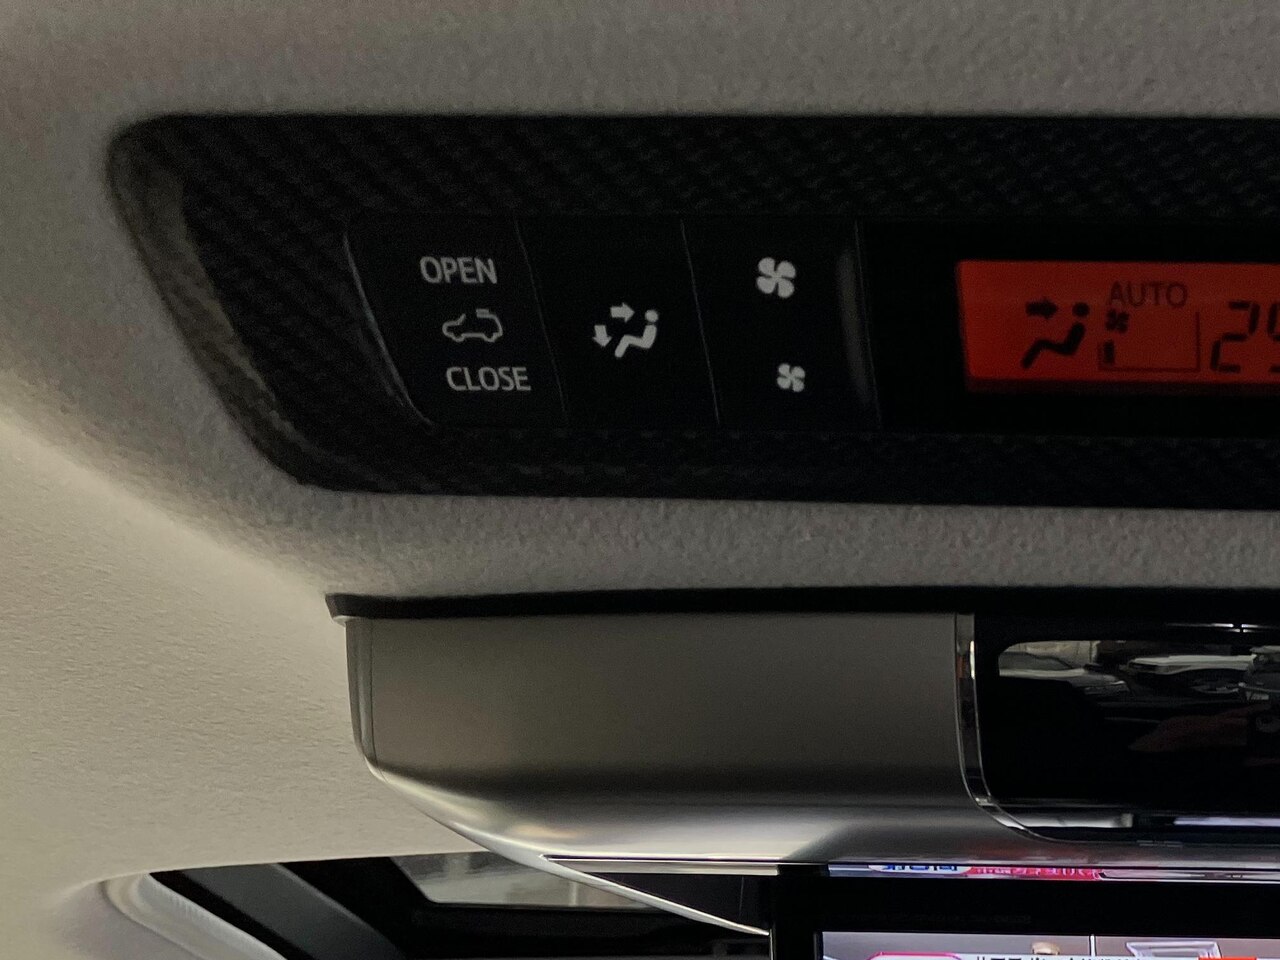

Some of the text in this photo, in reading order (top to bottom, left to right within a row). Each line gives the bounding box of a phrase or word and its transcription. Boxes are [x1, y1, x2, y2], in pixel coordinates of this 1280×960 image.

[419, 256, 498, 286] OPEN
[1109, 282, 1189, 309] AUTO
[446, 366, 532, 391] CLOSE
